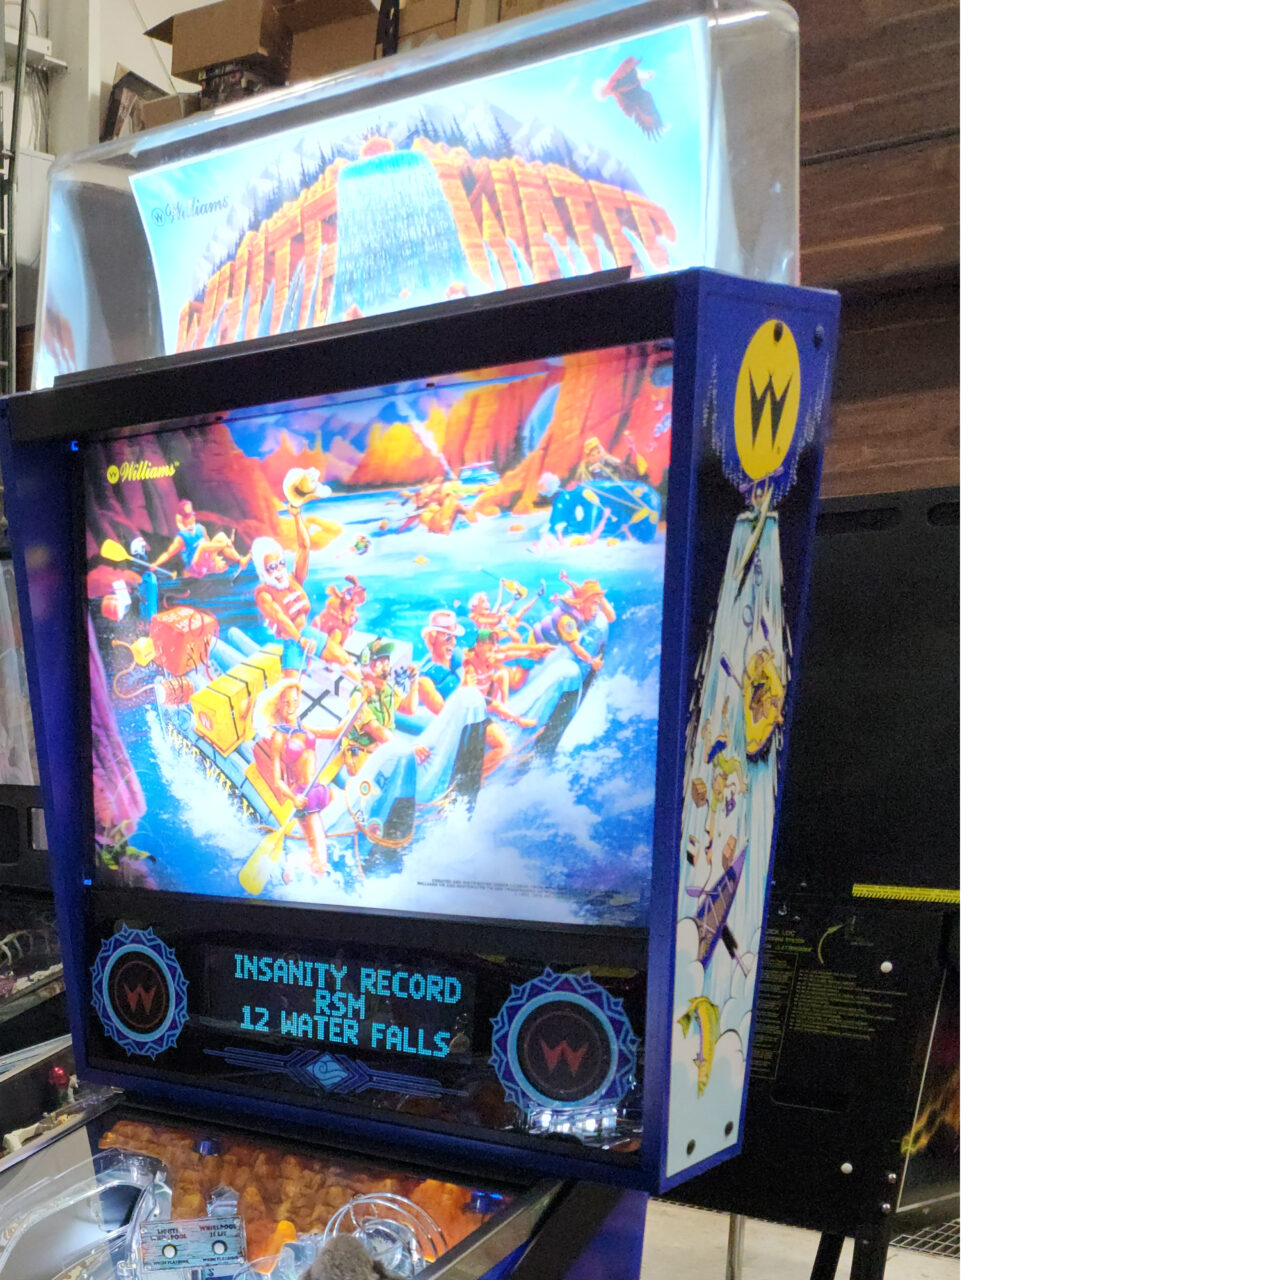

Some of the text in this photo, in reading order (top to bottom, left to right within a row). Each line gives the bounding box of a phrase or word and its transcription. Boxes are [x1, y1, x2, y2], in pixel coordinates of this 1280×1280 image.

[120, 460, 176, 483] Williams
[234, 954, 462, 1004] INSANITY RECORD
[315, 989, 365, 1020] RSM
[240, 1005, 451, 1058] 12 WATER FALLS
